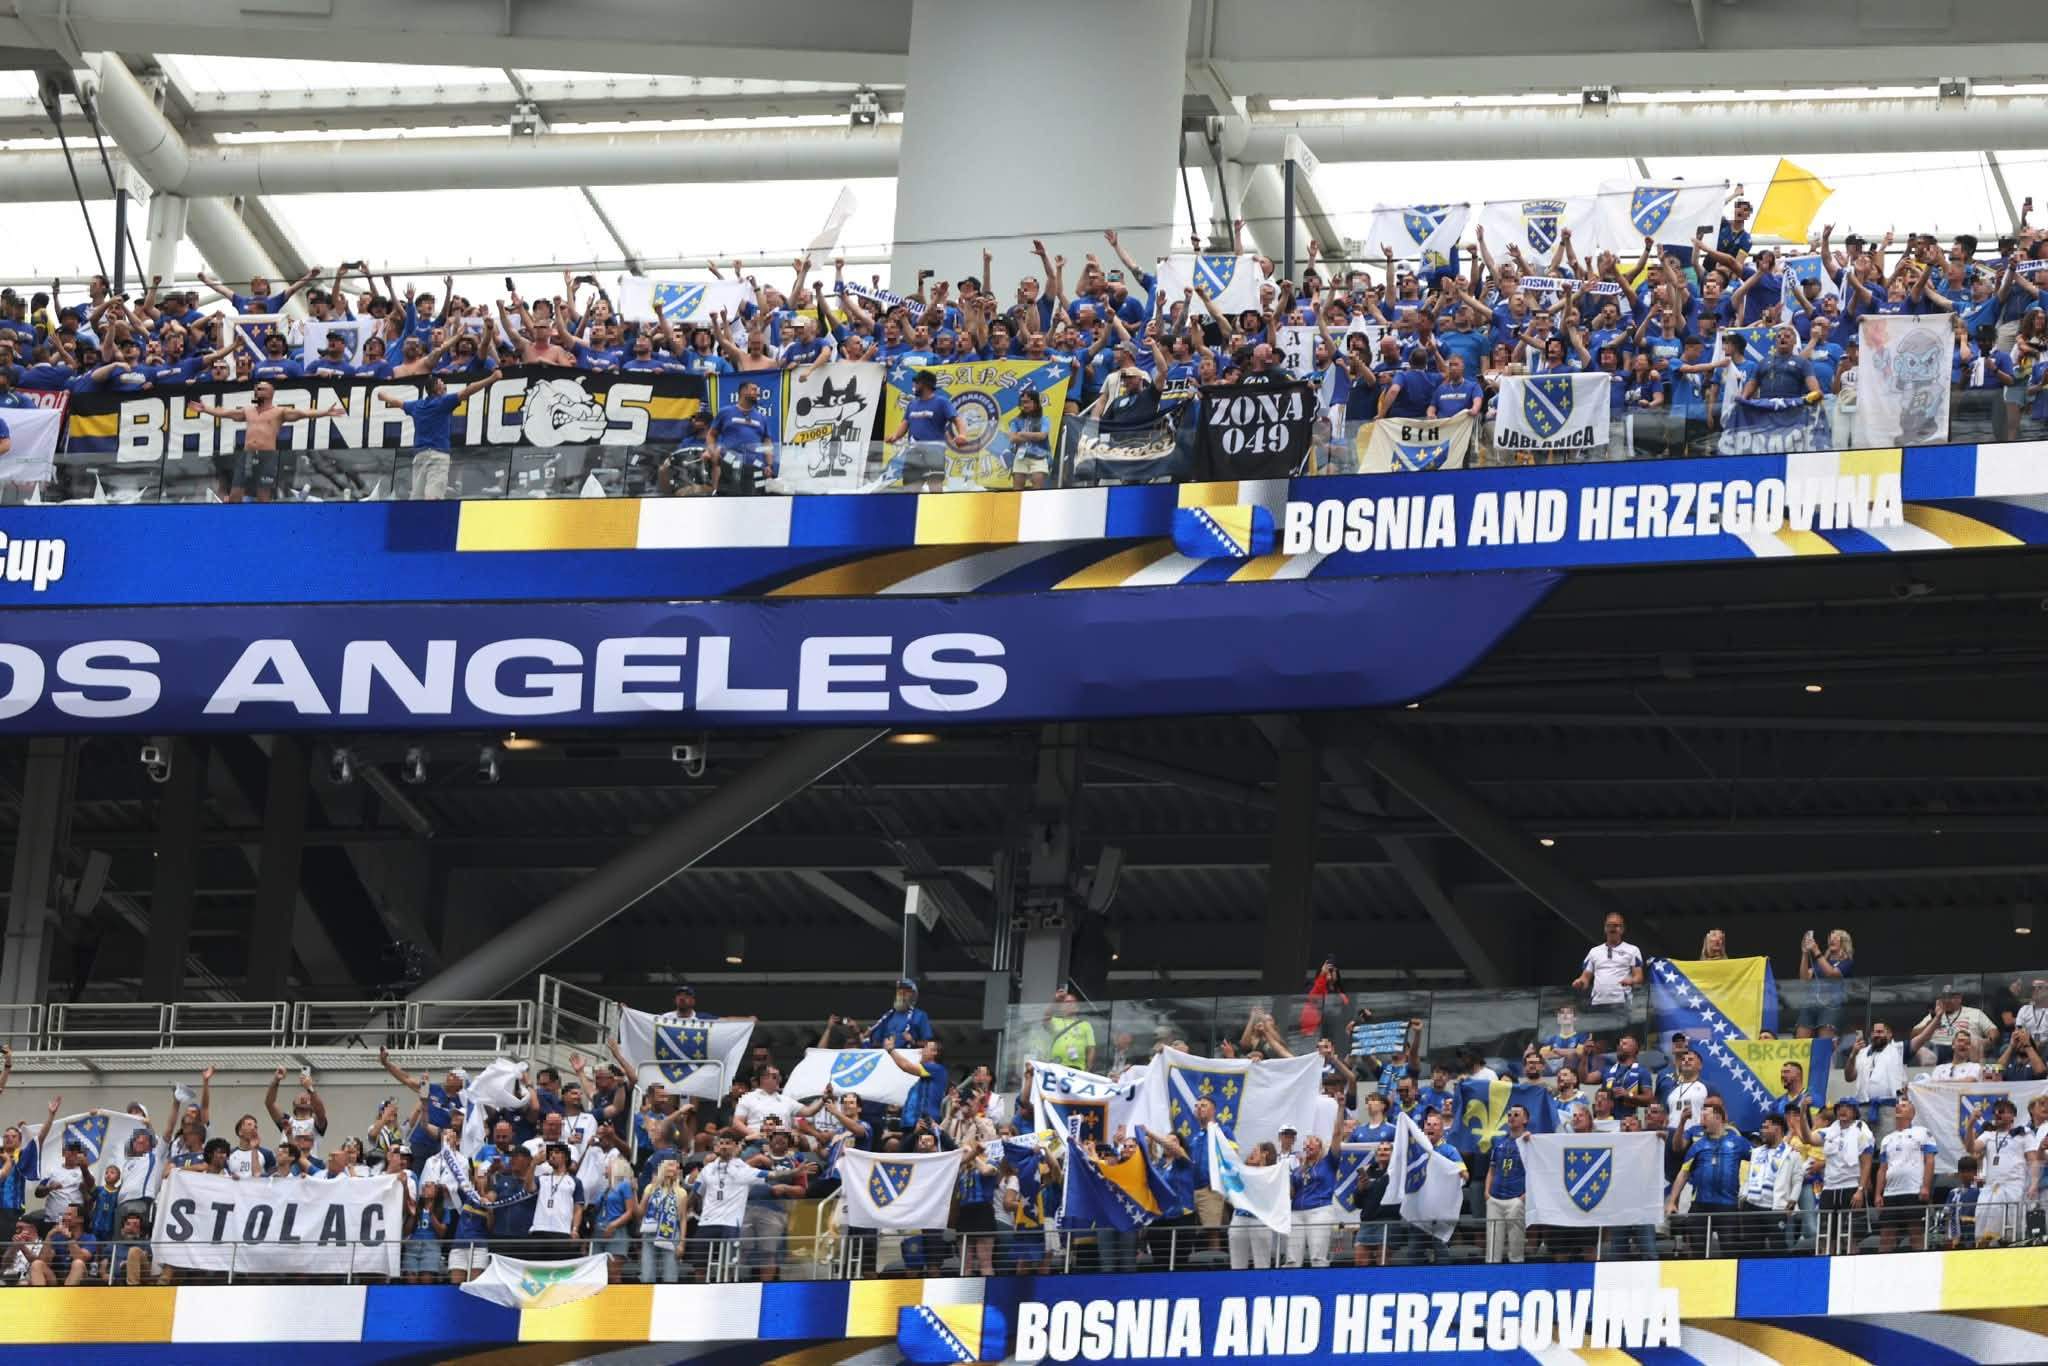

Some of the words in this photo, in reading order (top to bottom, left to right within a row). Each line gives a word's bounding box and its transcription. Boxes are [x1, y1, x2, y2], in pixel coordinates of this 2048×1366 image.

[1209, 391, 1304, 426] ZONA
[1221, 423, 1290, 455] 049
[1499, 425, 1595, 448] JABLANICA
[1283, 493, 1457, 555] BOSNIA
[1468, 488, 1568, 546] AND
[1579, 472, 1905, 542] HERZEGOVINA
[203, 632, 1008, 718] ANGELES
[165, 1198, 387, 1248] STOLAC
[1015, 1295, 1203, 1362] BOSNIA
[1213, 1293, 1321, 1358] AND
[1332, 1286, 1682, 1355] HERZEGOVINA
